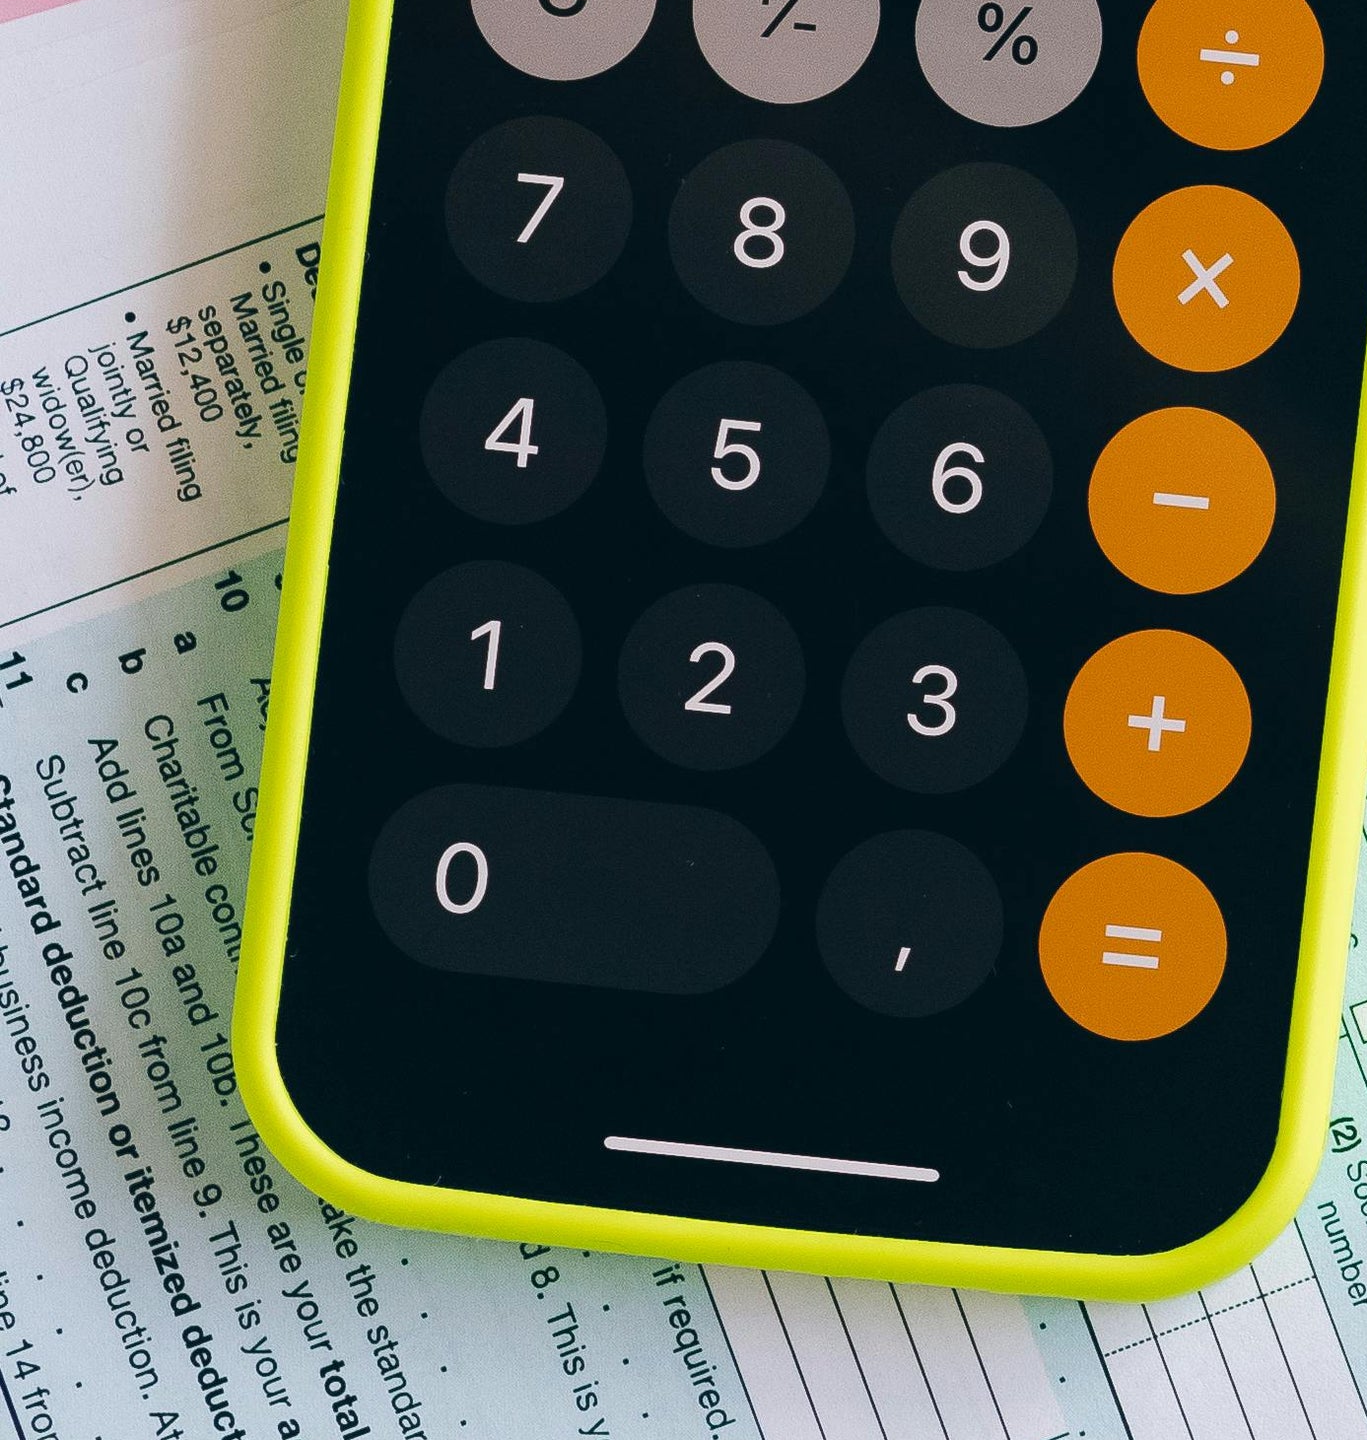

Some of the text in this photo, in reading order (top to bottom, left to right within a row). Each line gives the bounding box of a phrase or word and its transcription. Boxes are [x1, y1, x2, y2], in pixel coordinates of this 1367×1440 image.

[978, 2, 1038, 65] %
[517, 173, 1009, 291] 7 8 9
[165, 315, 225, 423] $12,400
[0, 377, 57, 485] $24,800
[125, 330, 204, 503] Married filing
[485, 398, 984, 513] 4 5 6
[213, 563, 255, 614] 10
[471, 621, 957, 736] 1 2 3
[35, 753, 108, 897] Subtract
[436, 843, 488, 914] 0
[87, 898, 127, 961] line
[114, 966, 152, 1030] 10c
[137, 1033, 183, 1115] from
[166, 1116, 206, 1179] line
[1327, 1116, 1363, 1154] (2)
[192, 1182, 224, 1219] 9.
[208, 1218, 249, 1295] This
[233, 1298, 262, 1331] is
[530, 1265, 561, 1301] 8.
[546, 1301, 587, 1377] This
[572, 1379, 600, 1413] is
[239, 1335, 293, 1408] your
